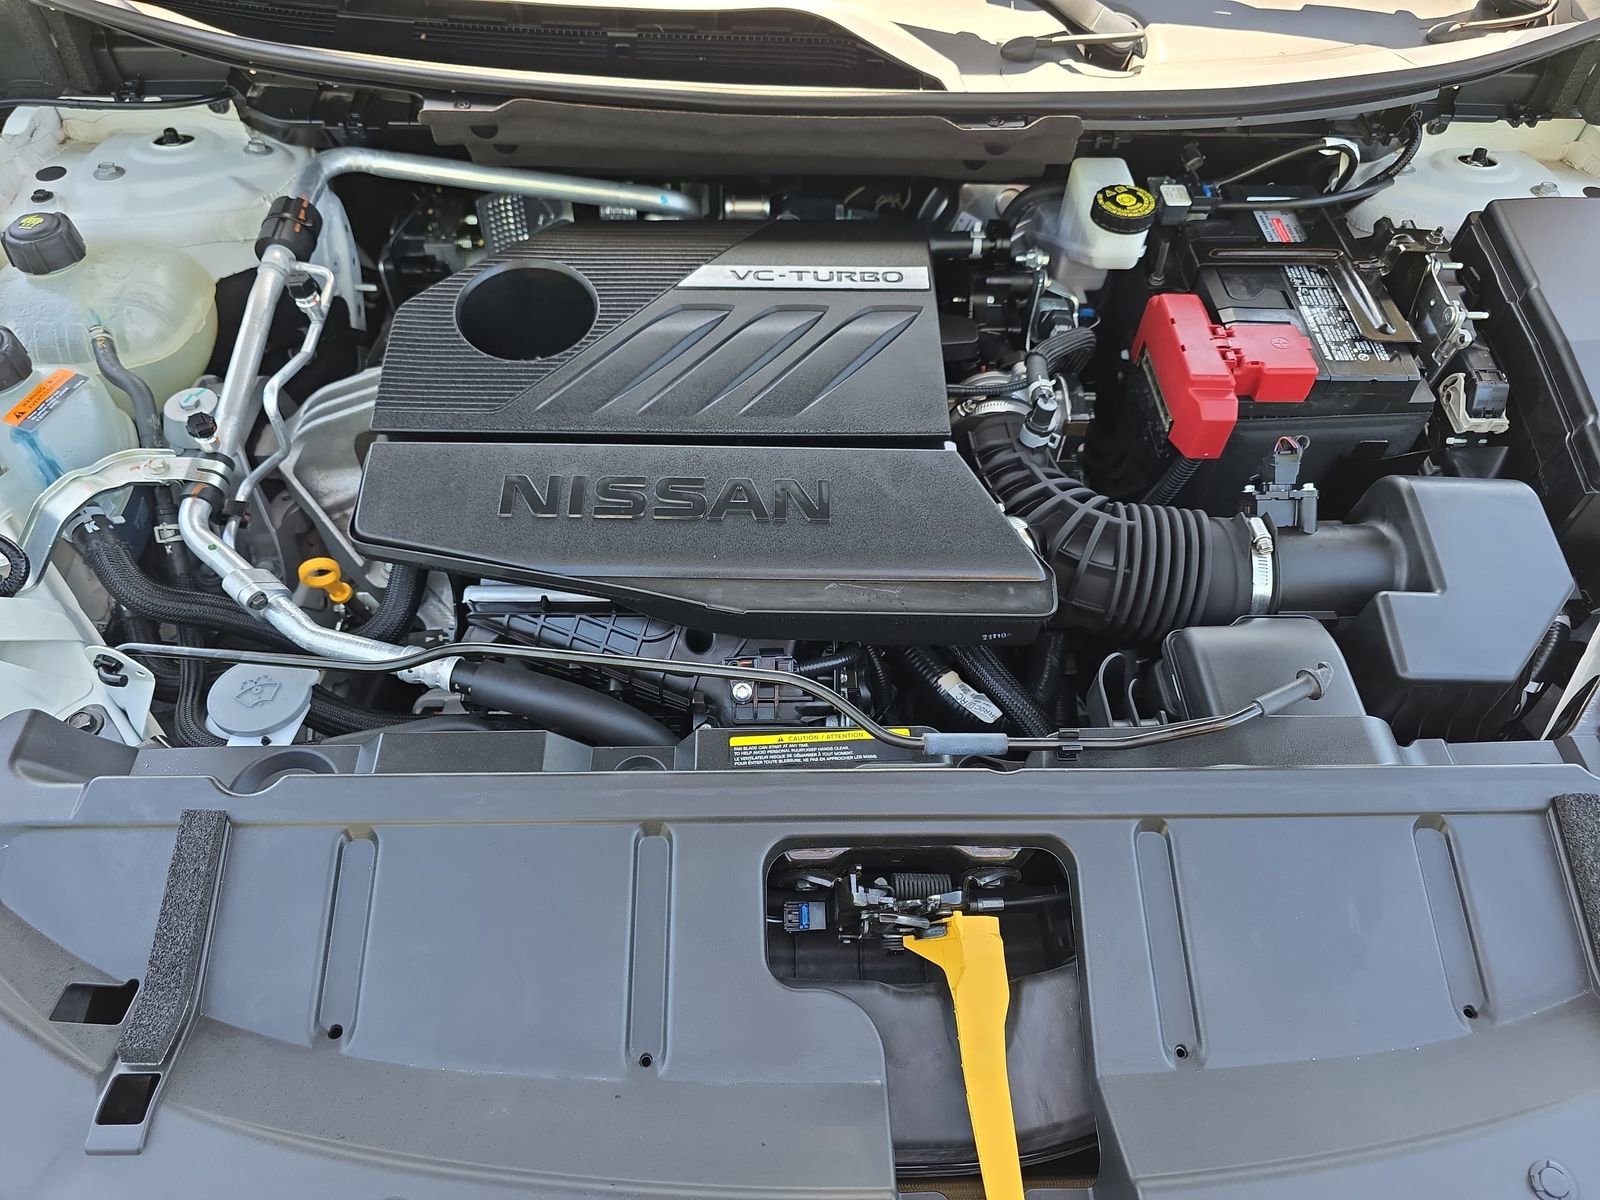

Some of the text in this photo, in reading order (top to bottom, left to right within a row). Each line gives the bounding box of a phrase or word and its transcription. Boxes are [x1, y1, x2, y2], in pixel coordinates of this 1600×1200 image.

[730, 270, 904, 283] VC-TURBO
[498, 474, 831, 522] NISSAN
[826, 732, 864, 740] ATTENTION
